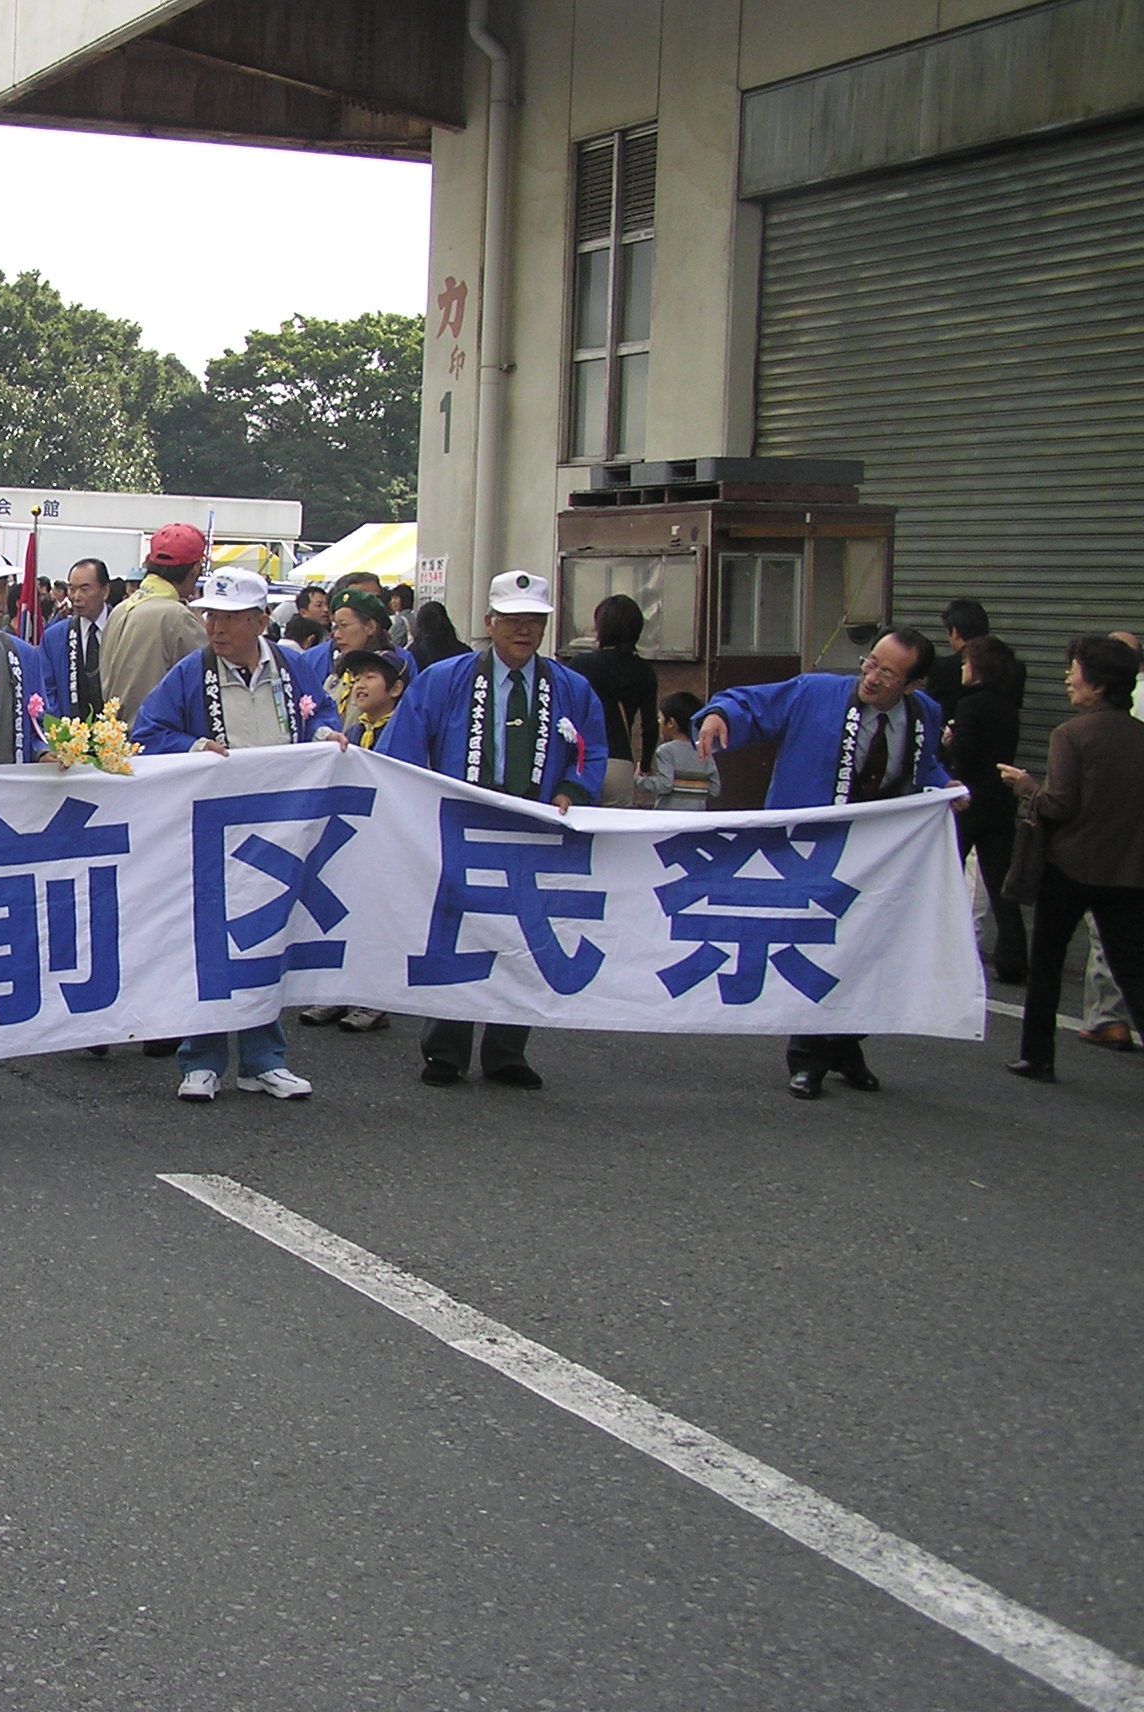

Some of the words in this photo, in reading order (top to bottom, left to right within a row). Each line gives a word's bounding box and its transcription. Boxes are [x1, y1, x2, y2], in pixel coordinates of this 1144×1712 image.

[466, 675, 488, 783] みやまえ区民祭
[531, 677, 550, 785] みやまえ区民祭
